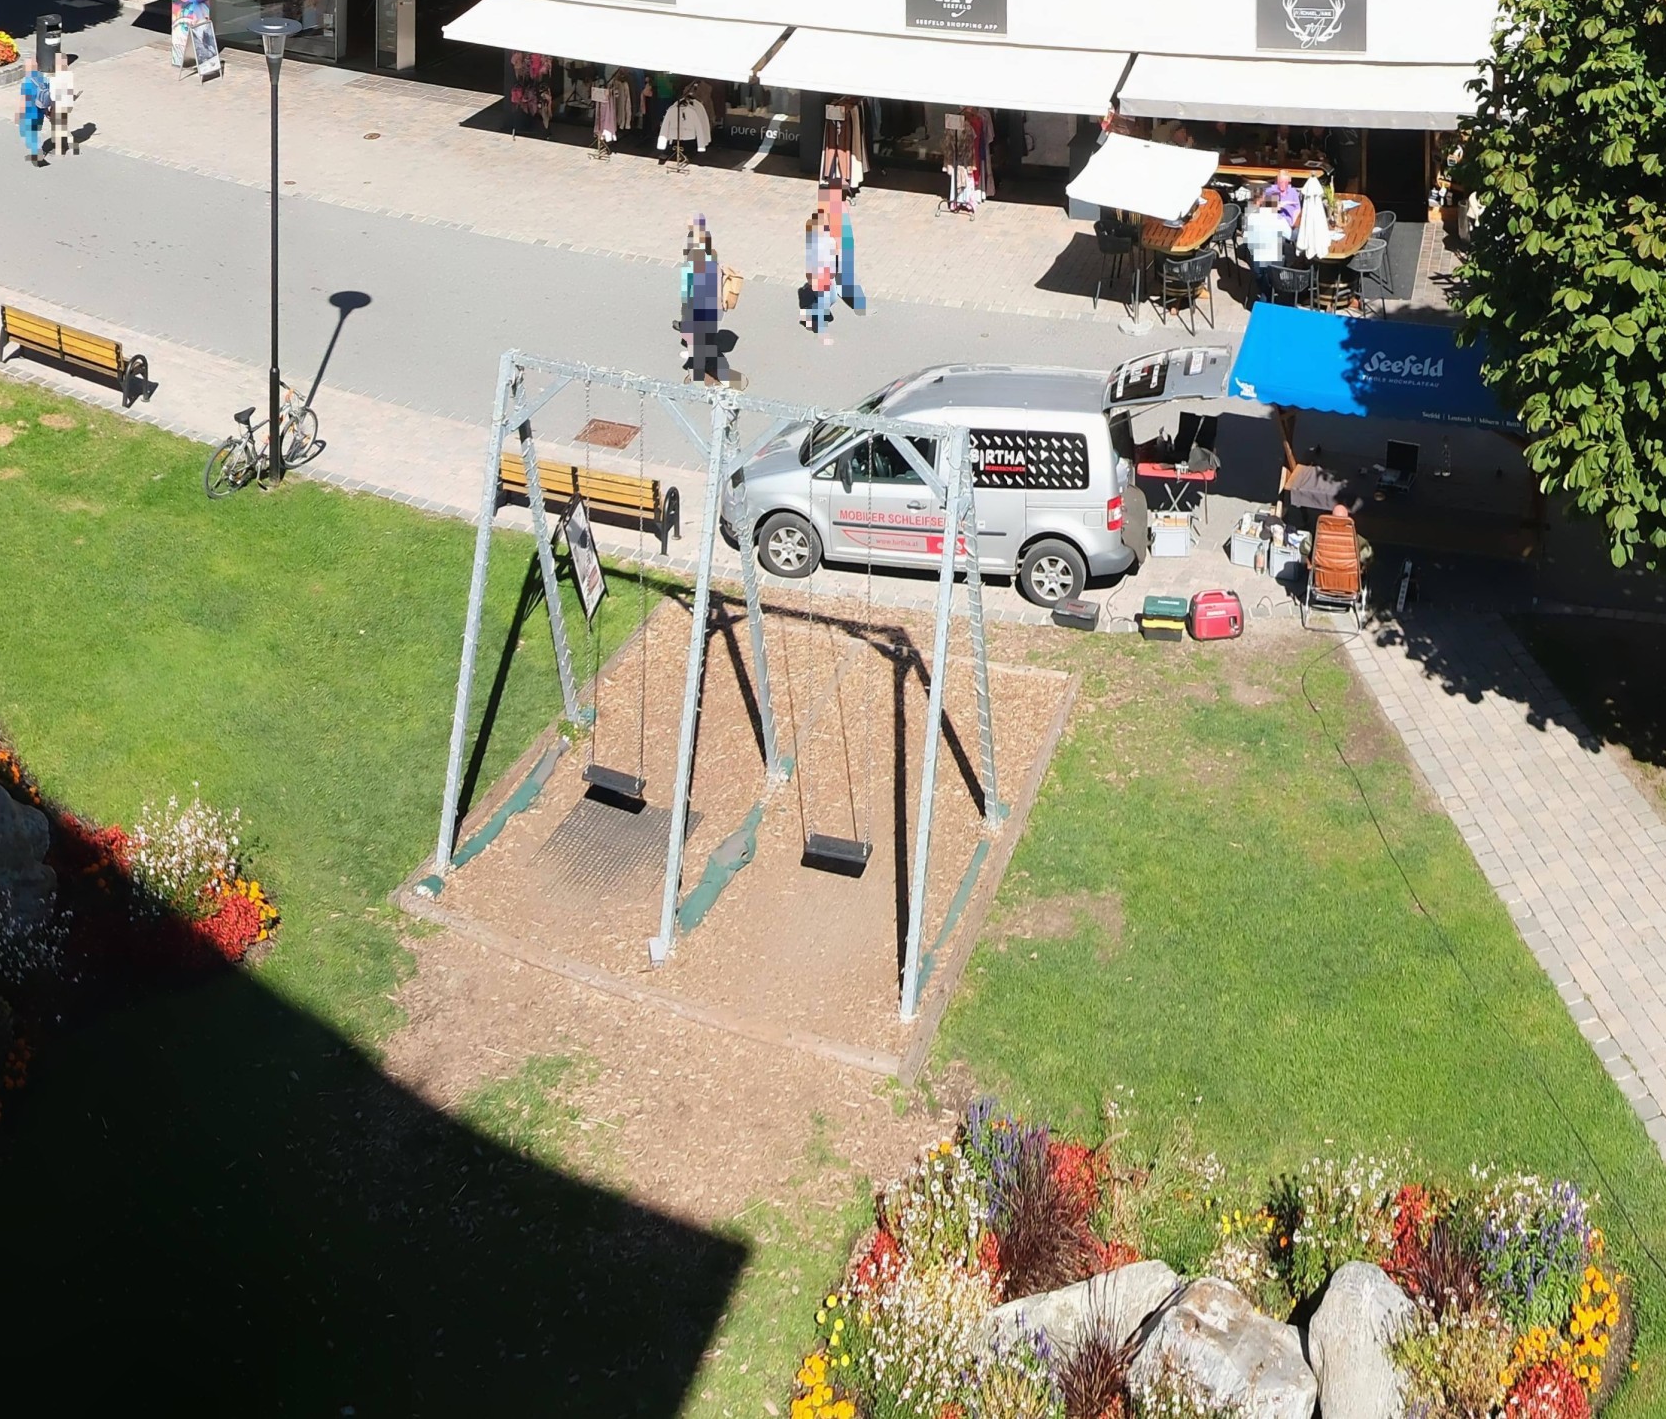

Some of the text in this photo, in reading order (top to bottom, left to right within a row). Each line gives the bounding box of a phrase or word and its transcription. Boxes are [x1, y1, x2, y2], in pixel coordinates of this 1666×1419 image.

[942, 2, 972, 10] SEEFELD
[947, 21, 982, 29] SHOPPING
[731, 125, 756, 136] pure
[1364, 351, 1444, 378] Seefeld
[1388, 377, 1440, 388] HOCHPLATEAU
[970, 448, 1026, 471] BIRTHA
